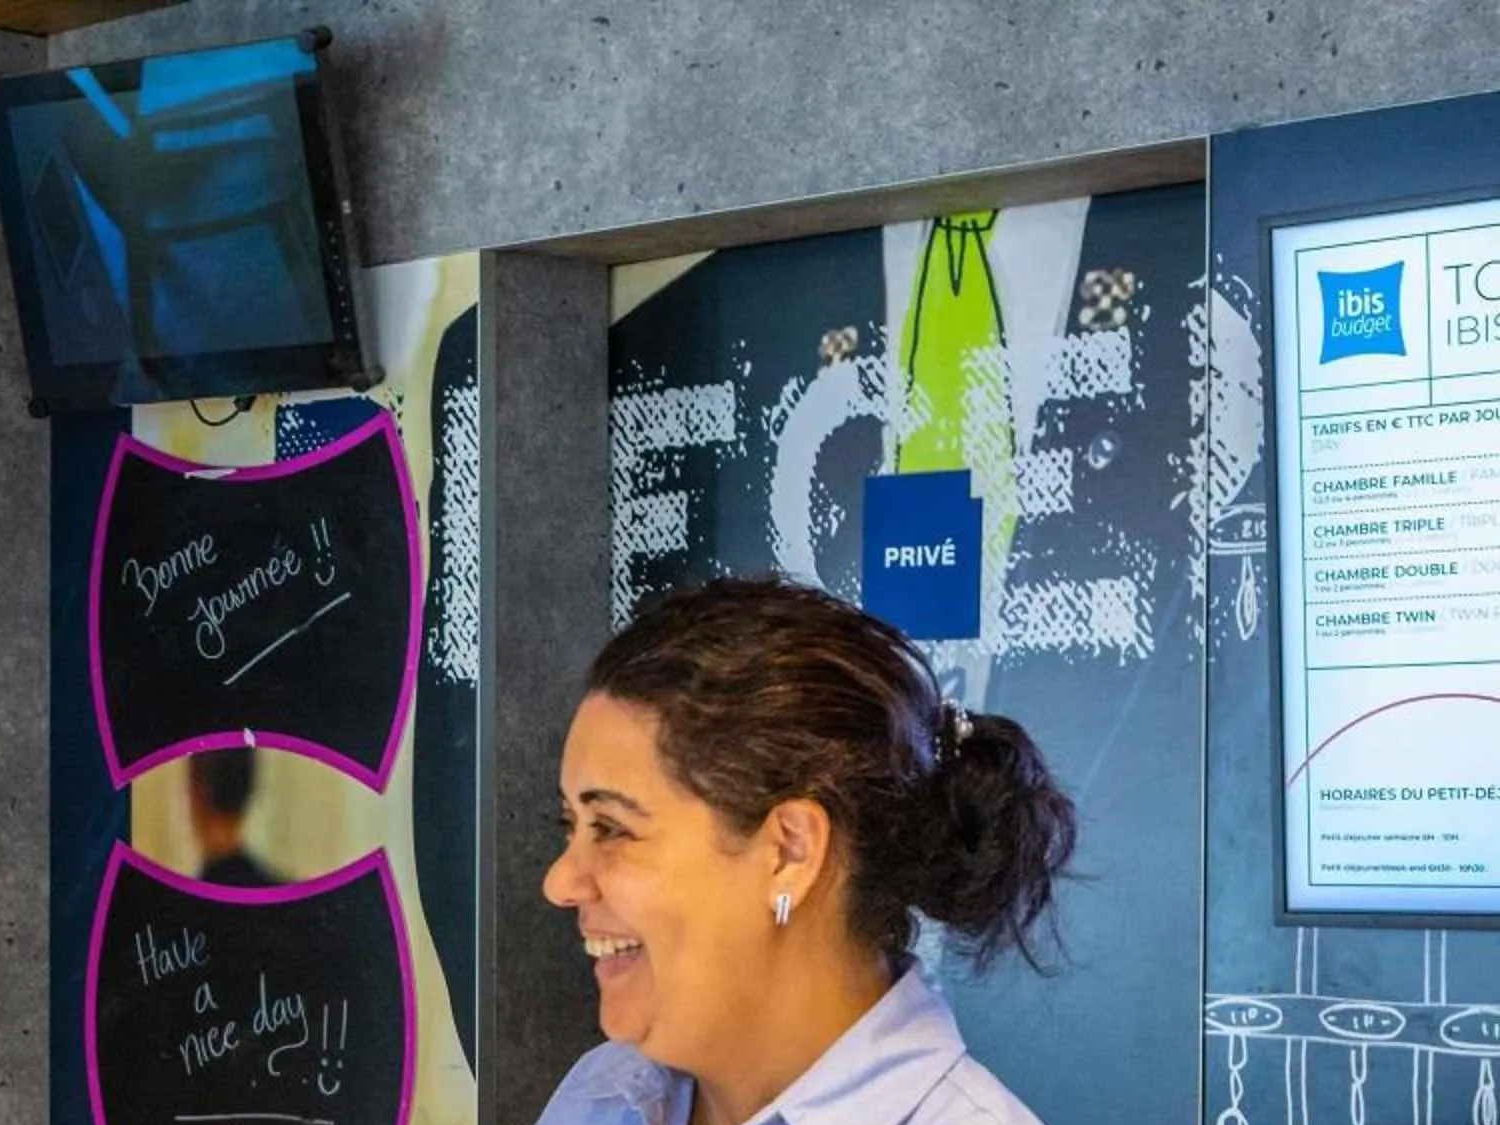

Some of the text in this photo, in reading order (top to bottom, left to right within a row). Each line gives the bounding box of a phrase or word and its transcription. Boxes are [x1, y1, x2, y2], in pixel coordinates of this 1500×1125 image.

[1338, 287, 1385, 317] ibis
[1331, 313, 1392, 338] budget
[1311, 420, 1362, 437] TARIFS
[1367, 419, 1387, 433] EN
[1391, 417, 1403, 430] €
[1407, 413, 1434, 429] TTC
[1439, 410, 1470, 425] PAR
[1312, 475, 1388, 495] CHAMBRE
[1393, 469, 1458, 487] FAMILLE
[1313, 521, 1389, 538] CHAMBRE
[1394, 516, 1445, 533] TRIPLE
[883, 536, 957, 569] PRIVÉ
[121, 533, 219, 617] Bonne
[1314, 565, 1390, 583] CHAMBRE
[1394, 561, 1458, 579] DOUBLE
[1315, 611, 1392, 627] CHAMBRE
[1395, 609, 1436, 624] TWIN
[1320, 787, 1397, 801] HORAIRES
[1401, 787, 1423, 801] DU
[134, 923, 212, 986] Have
[193, 980, 219, 1014] a
[179, 1018, 241, 1077] nice
[251, 971, 310, 1078] day
